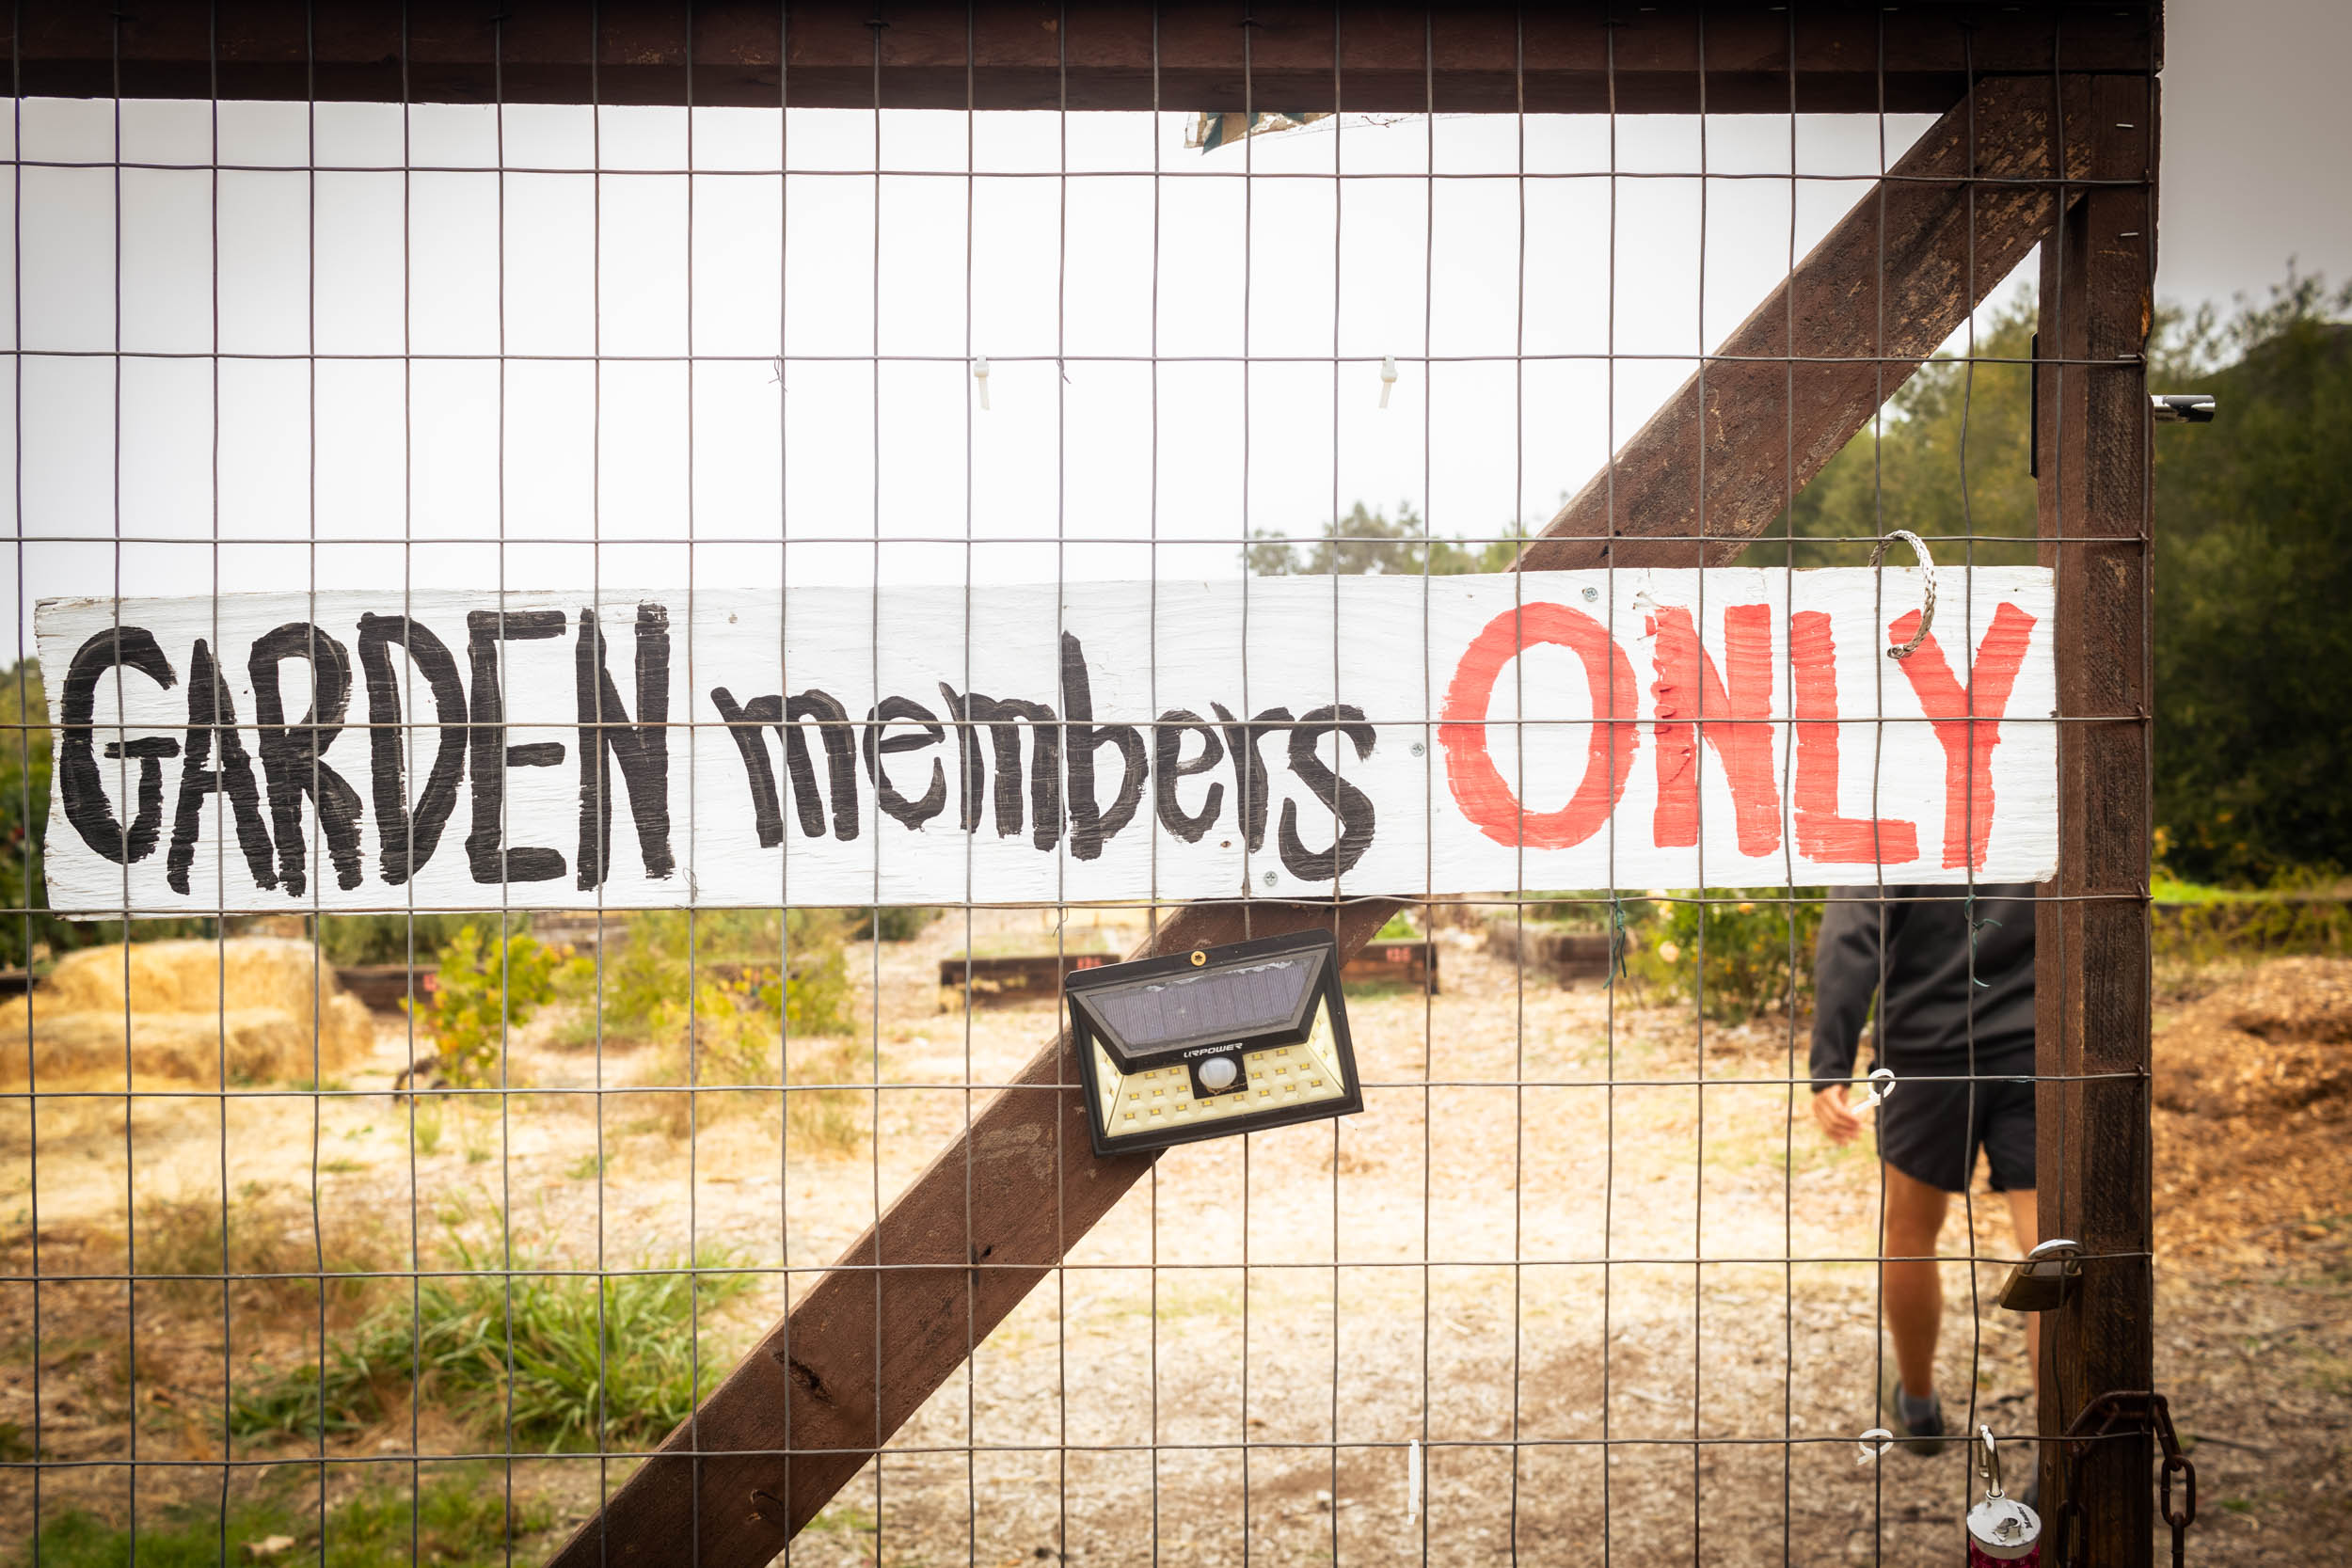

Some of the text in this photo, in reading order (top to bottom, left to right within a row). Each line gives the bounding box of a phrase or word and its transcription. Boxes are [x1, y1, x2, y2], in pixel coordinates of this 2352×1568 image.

[59, 601, 2038, 897] GARDEN members ONLY
[1184, 1043, 1244, 1058] URPOWER
